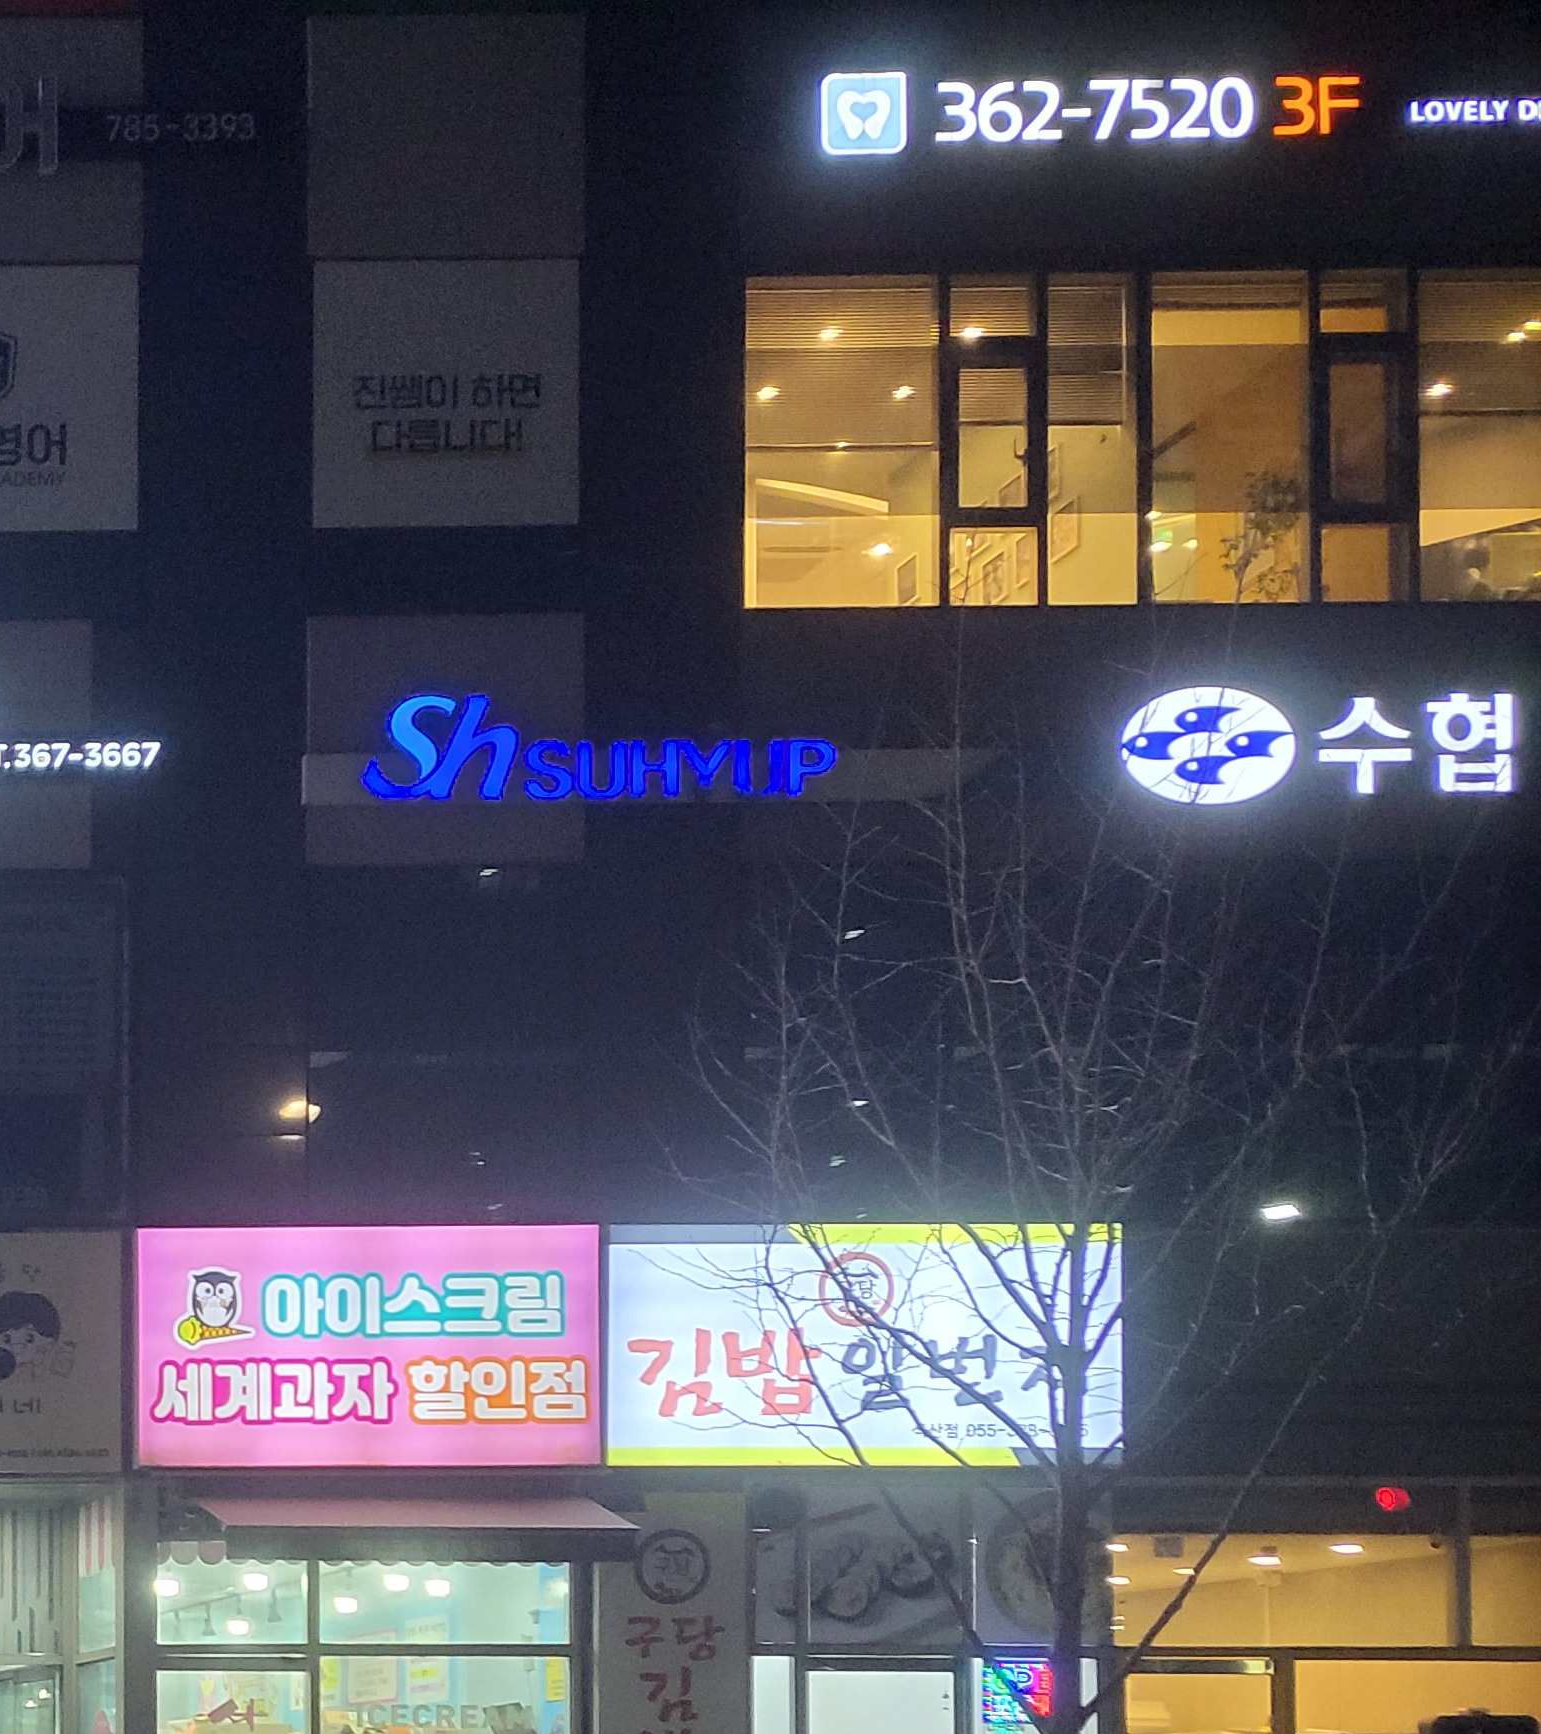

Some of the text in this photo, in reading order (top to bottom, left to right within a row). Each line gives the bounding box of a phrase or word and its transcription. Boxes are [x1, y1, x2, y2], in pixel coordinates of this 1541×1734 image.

[105, 112, 257, 142] 785-3393
[934, 77, 1257, 143] 362-7520
[1272, 75, 1362, 136] 3F
[1409, 98, 1509, 124] LOVELY
[521, 737, 838, 800] SUHYUP
[1317, 693, 1517, 797] 수협
[262, 1272, 566, 1339] 아이스크림
[151, 1355, 591, 1425] 세계과자 할인점
[627, 1326, 822, 1418] 김밥
[625, 1614, 726, 1662] 구당
